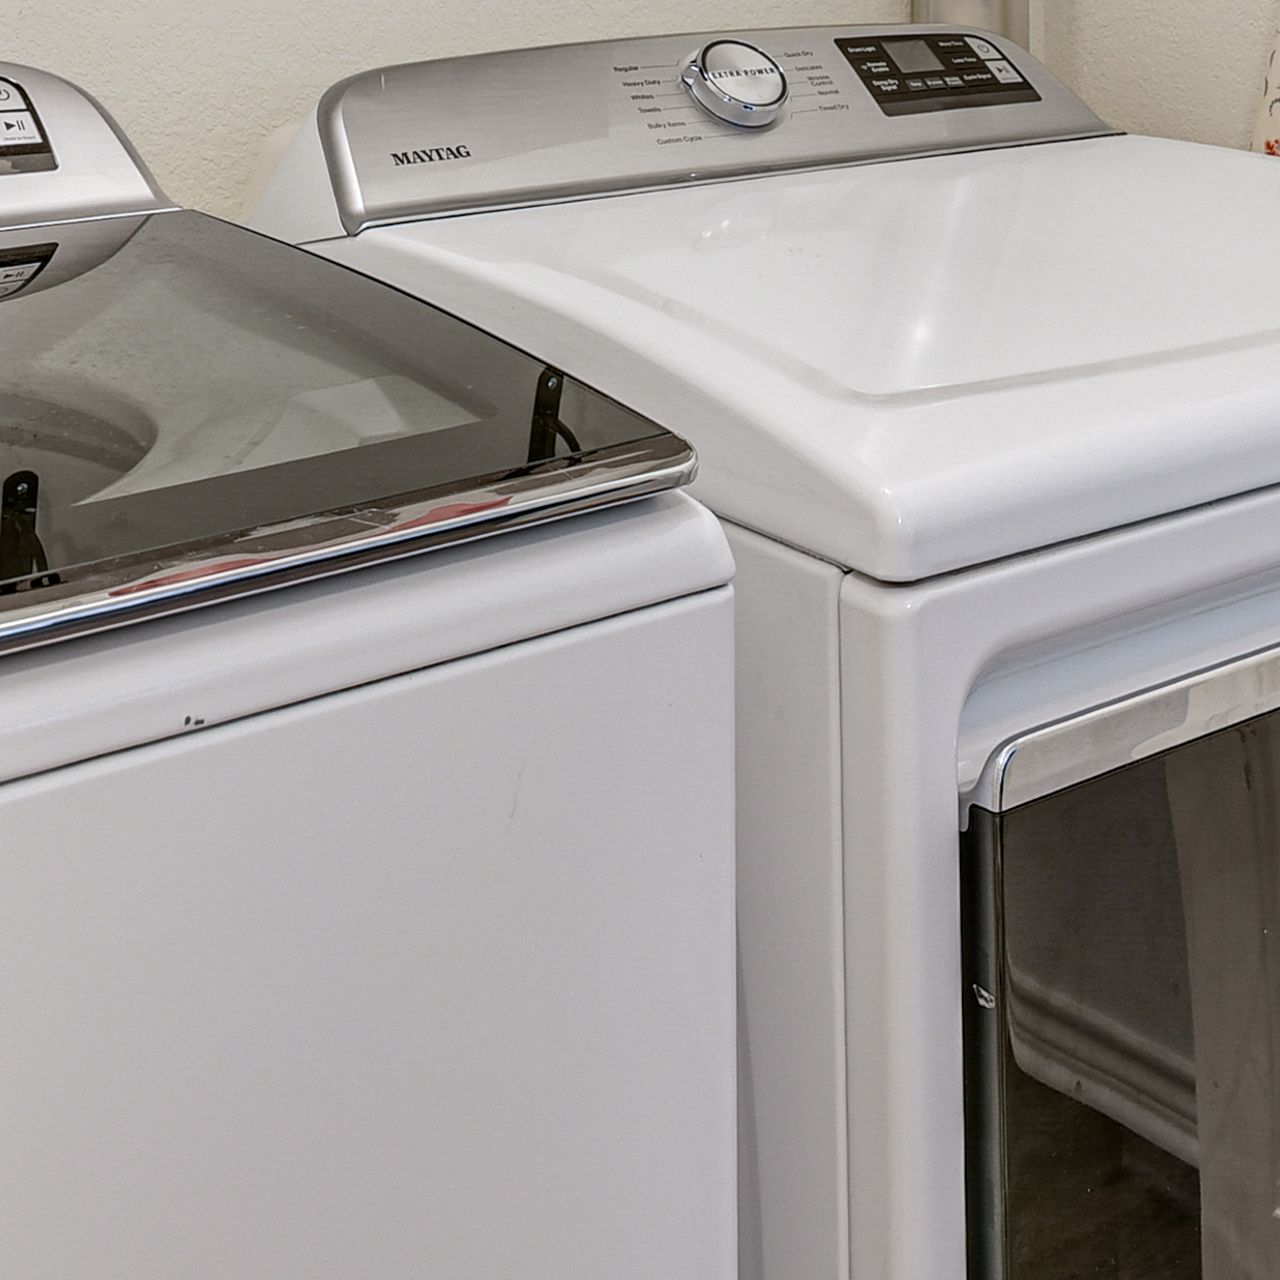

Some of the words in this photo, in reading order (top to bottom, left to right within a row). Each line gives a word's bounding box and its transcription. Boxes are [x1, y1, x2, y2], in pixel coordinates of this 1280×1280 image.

[712, 69, 741, 79] EXTRA
[744, 67, 776, 77] POWER
[389, 145, 471, 166] MAYTAG
